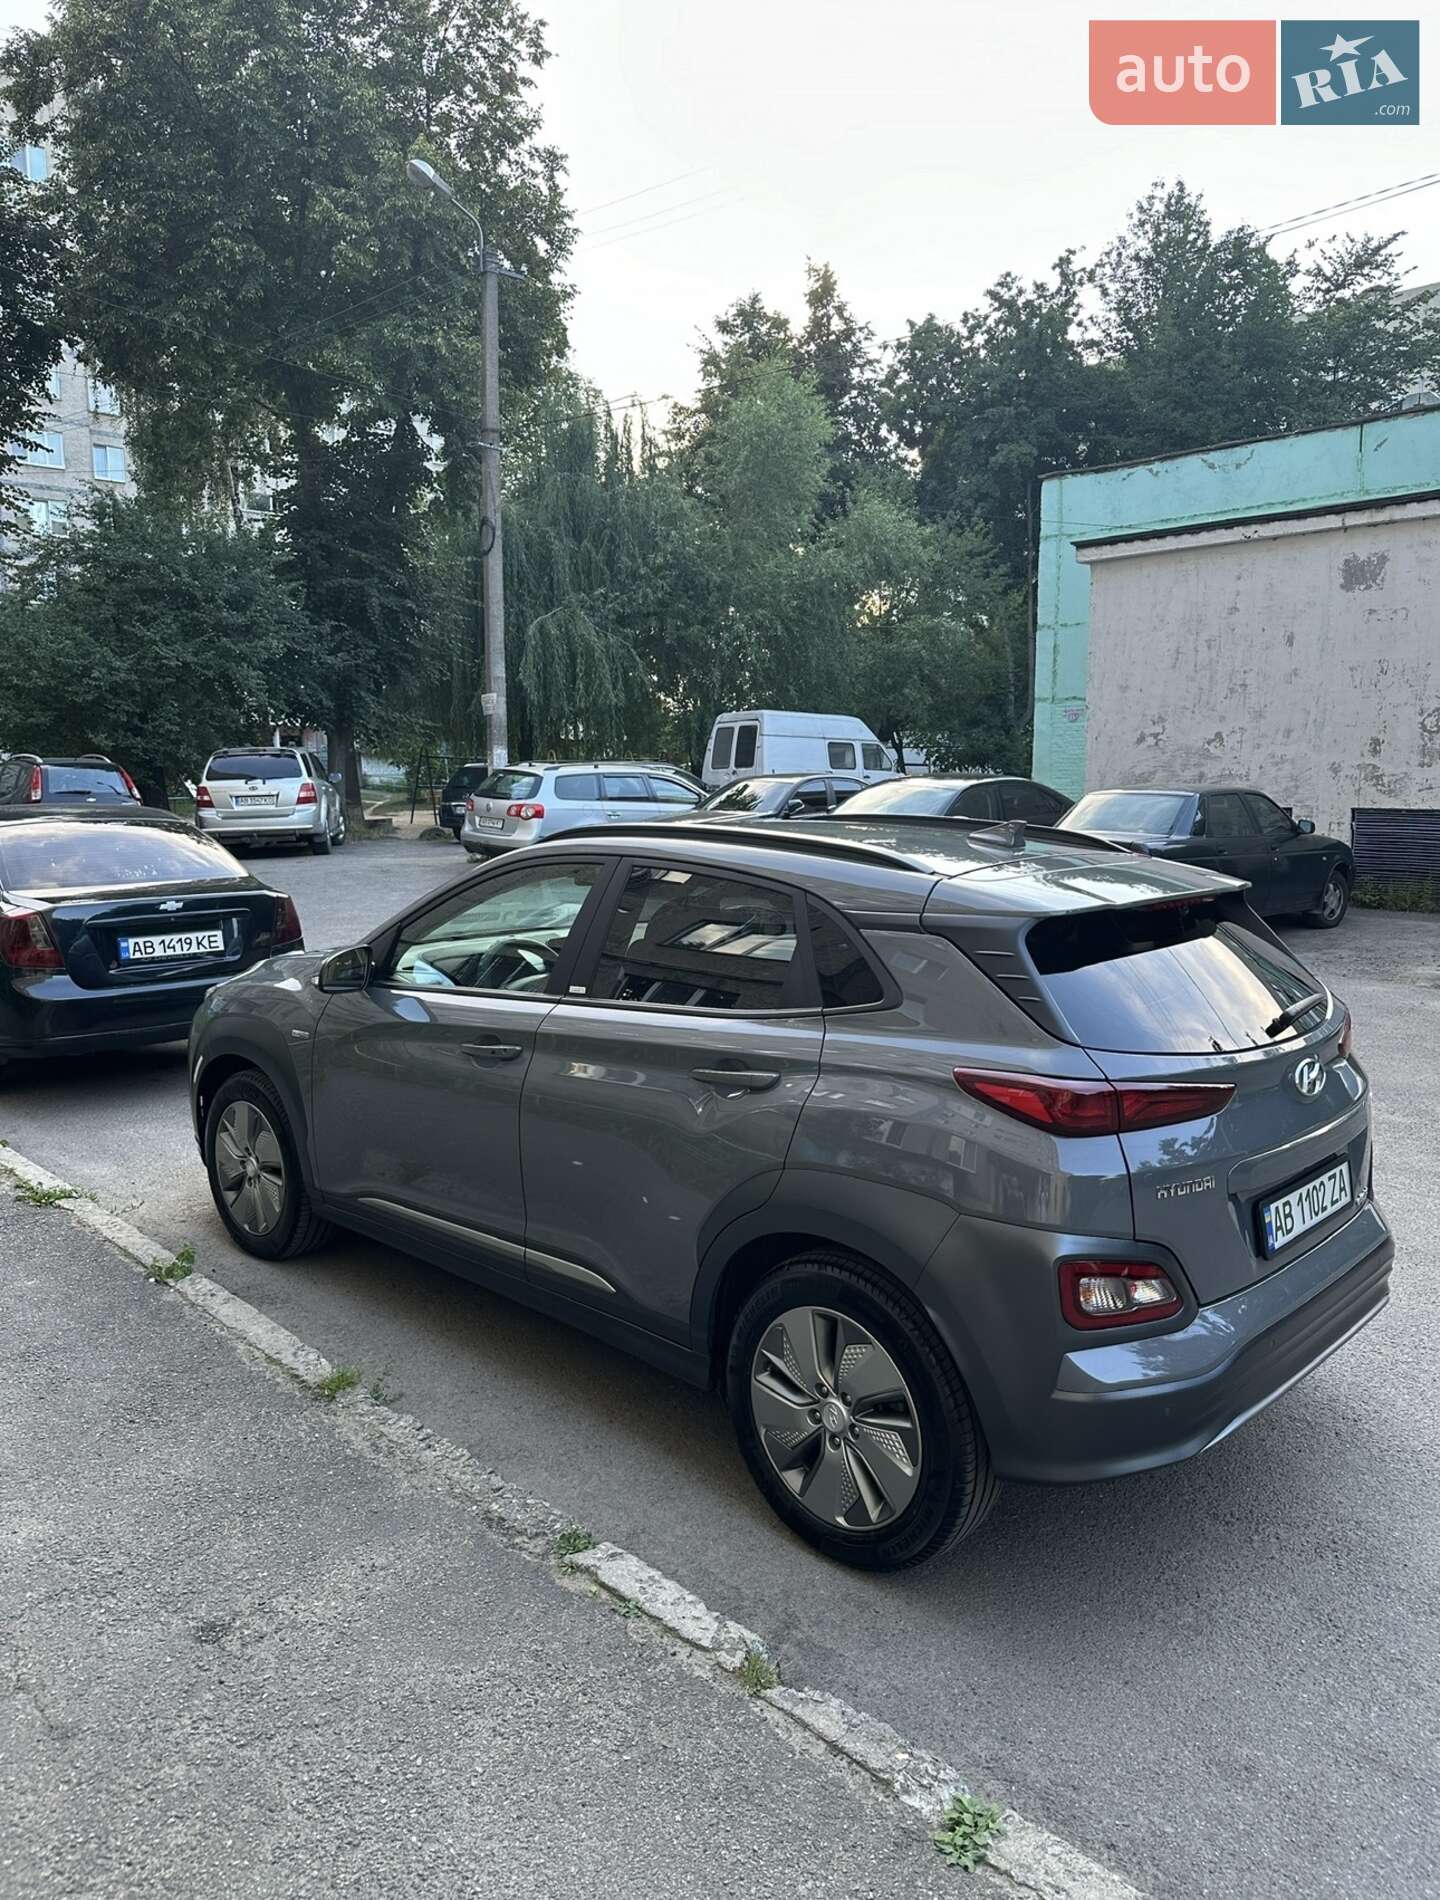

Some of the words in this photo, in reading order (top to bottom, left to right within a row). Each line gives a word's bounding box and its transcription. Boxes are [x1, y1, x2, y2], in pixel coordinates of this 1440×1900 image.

[132, 941, 155, 956] AB
[158, 937, 193, 953] 1419
[195, 934, 220, 950] KE
[1156, 1175, 1216, 1200] HYUNDAI
[1274, 1201, 1295, 1242] AB
[1297, 1183, 1328, 1225] 1102
[1328, 1169, 1348, 1208] ZA
